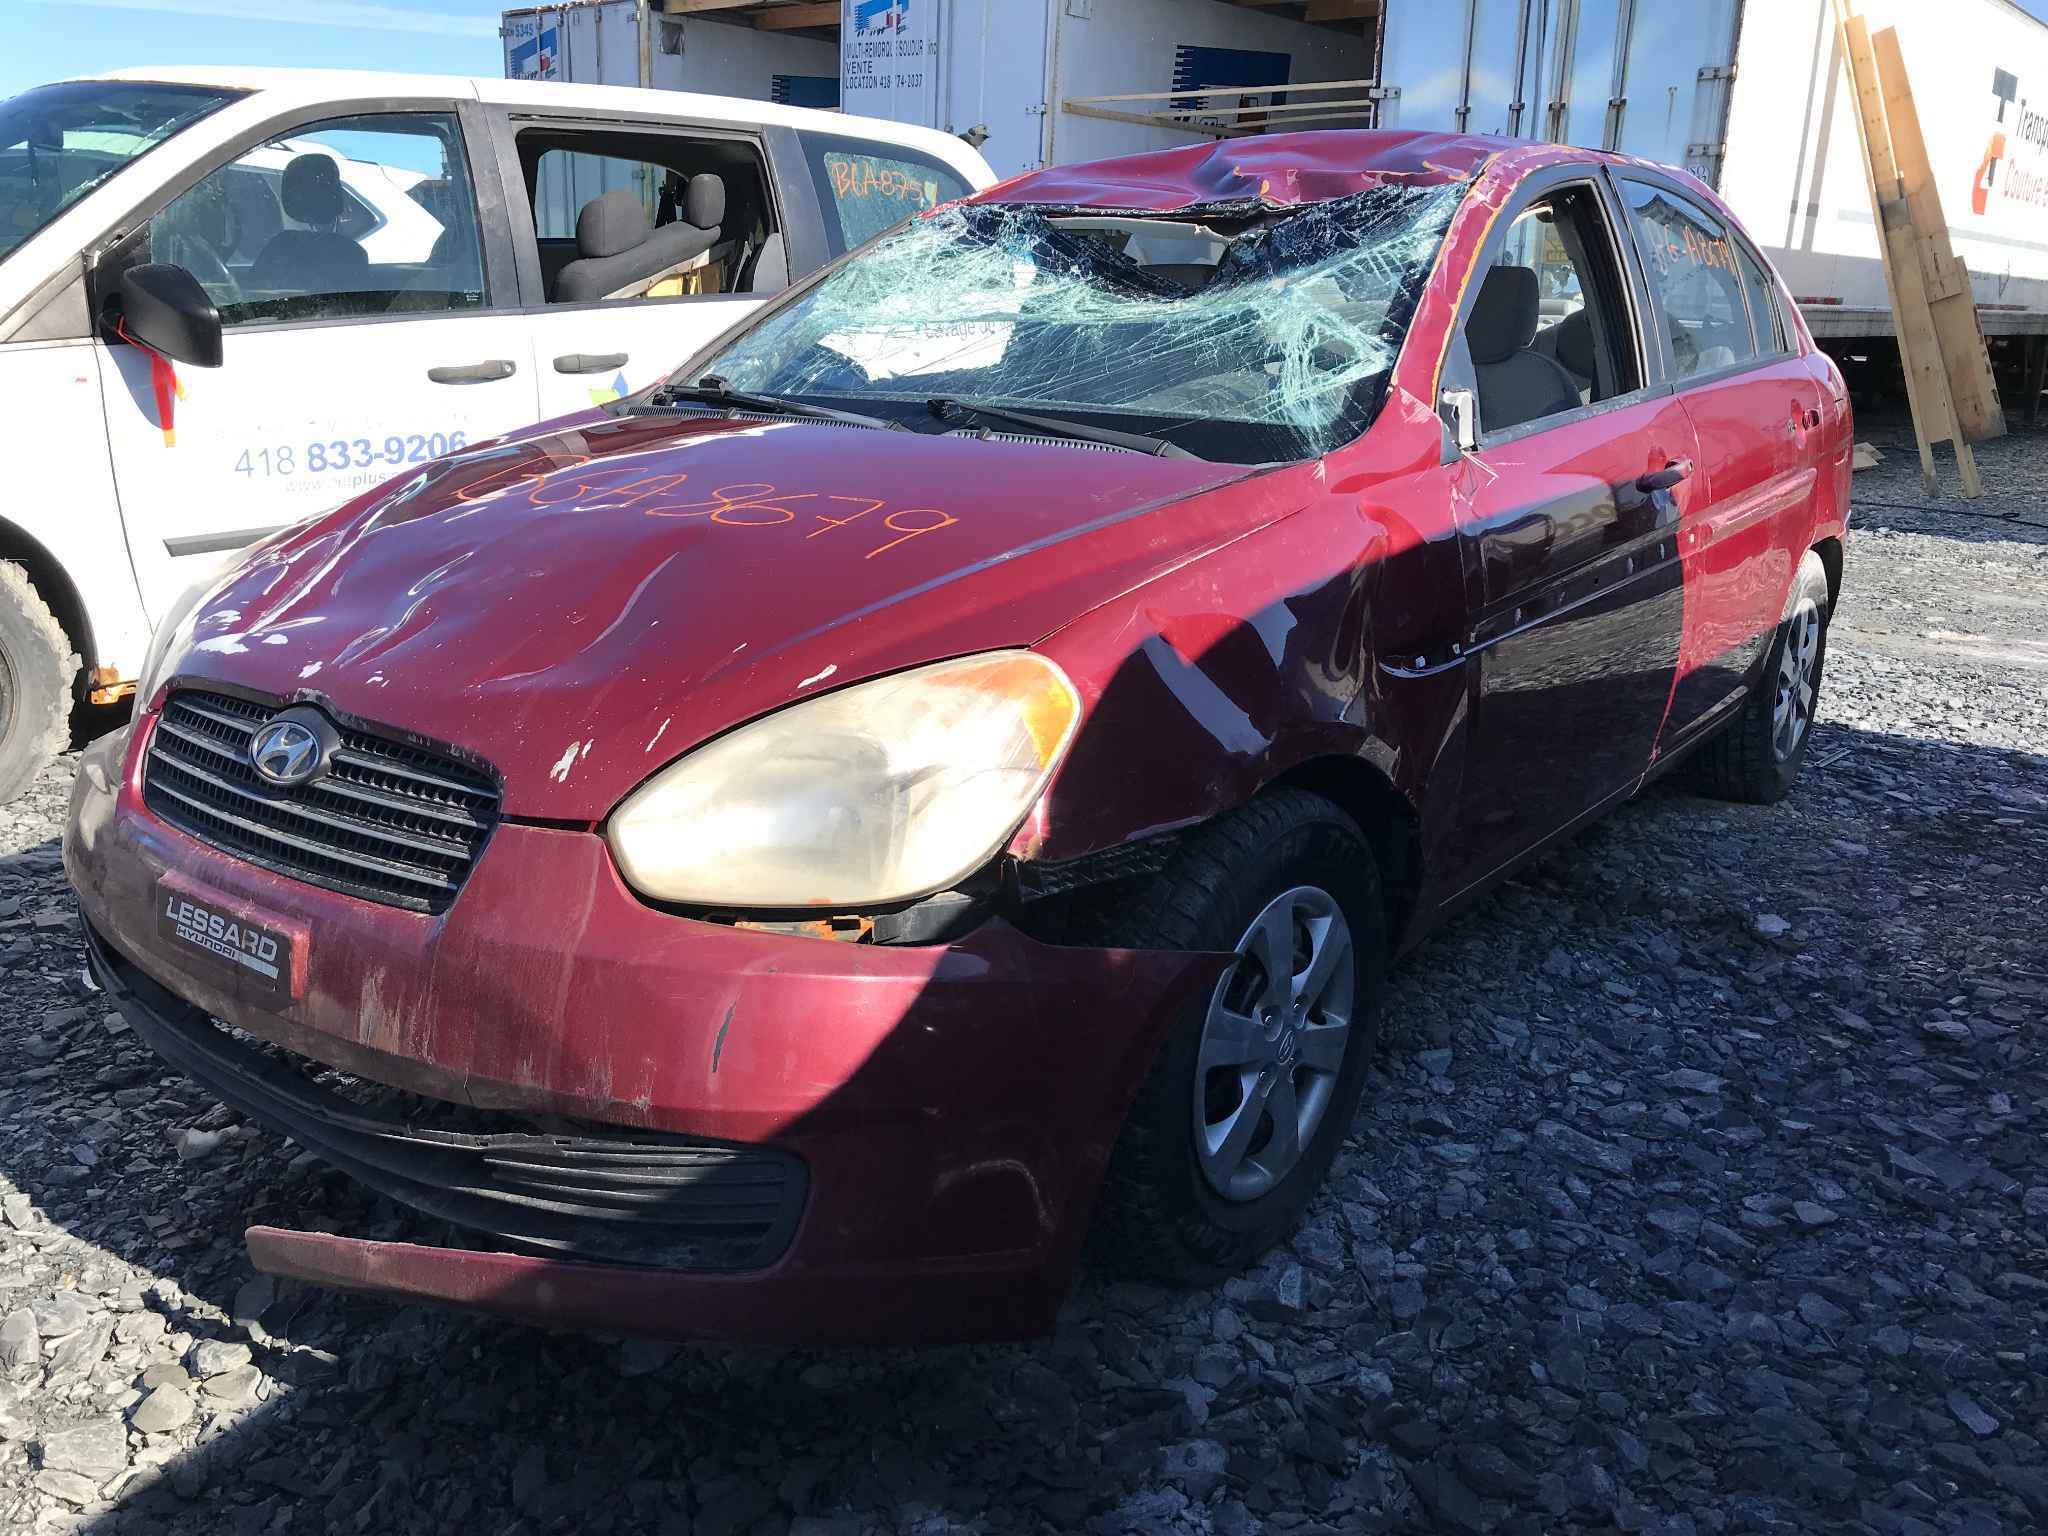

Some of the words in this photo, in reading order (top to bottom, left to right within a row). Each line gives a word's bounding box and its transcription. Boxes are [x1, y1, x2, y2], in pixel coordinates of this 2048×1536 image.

[845, 76, 878, 90] LOCATION
[880, 75, 891, 89] 418
[893, 73, 923, 88] 74-2037
[846, 60, 873, 74] VENTE
[2016, 98, 2048, 155] Transp
[234, 445, 296, 478] 418
[306, 430, 467, 473] 833-9206
[165, 895, 279, 962] LESSARD
[176, 923, 237, 960] HYUNDAI
